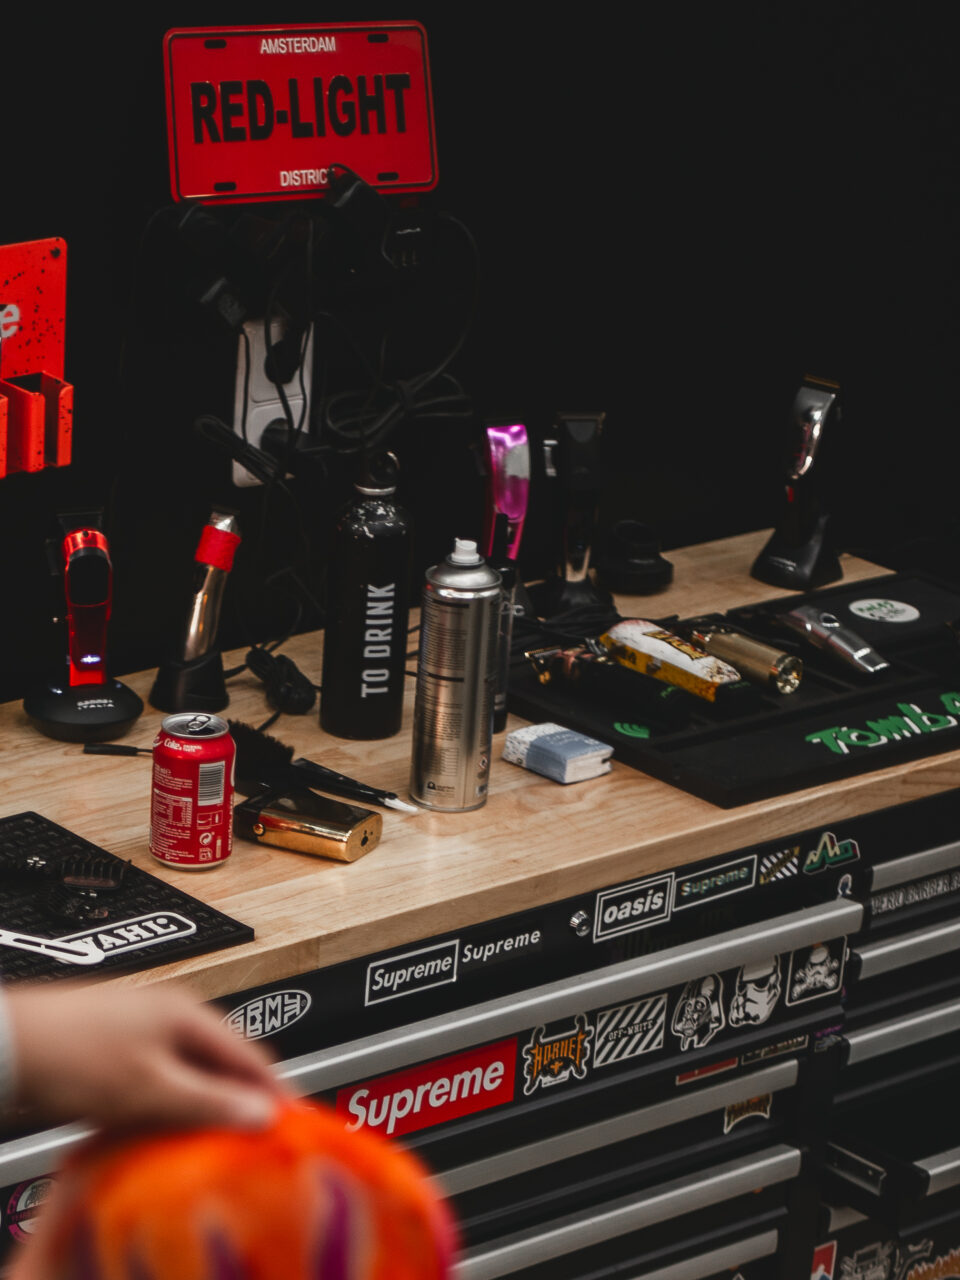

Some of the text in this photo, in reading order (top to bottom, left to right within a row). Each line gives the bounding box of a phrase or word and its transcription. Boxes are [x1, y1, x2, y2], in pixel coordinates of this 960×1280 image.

[260, 36, 336, 54] AMSTERDAM
[190, 73, 411, 144] RED-LIGHT
[280, 167, 335, 187] DISTRIC
[361, 582, 396, 698] TO DRINK
[164, 738, 180, 750] Coke
[681, 866, 749, 897] Supreme
[604, 889, 664, 924] oasis
[462, 929, 541, 963] Supreme
[371, 953, 452, 992] Supreme
[608, 1019, 654, 1042] OFF-WHITE
[530, 1029, 587, 1080] HORNET
[344, 1060, 505, 1135] Supreme
